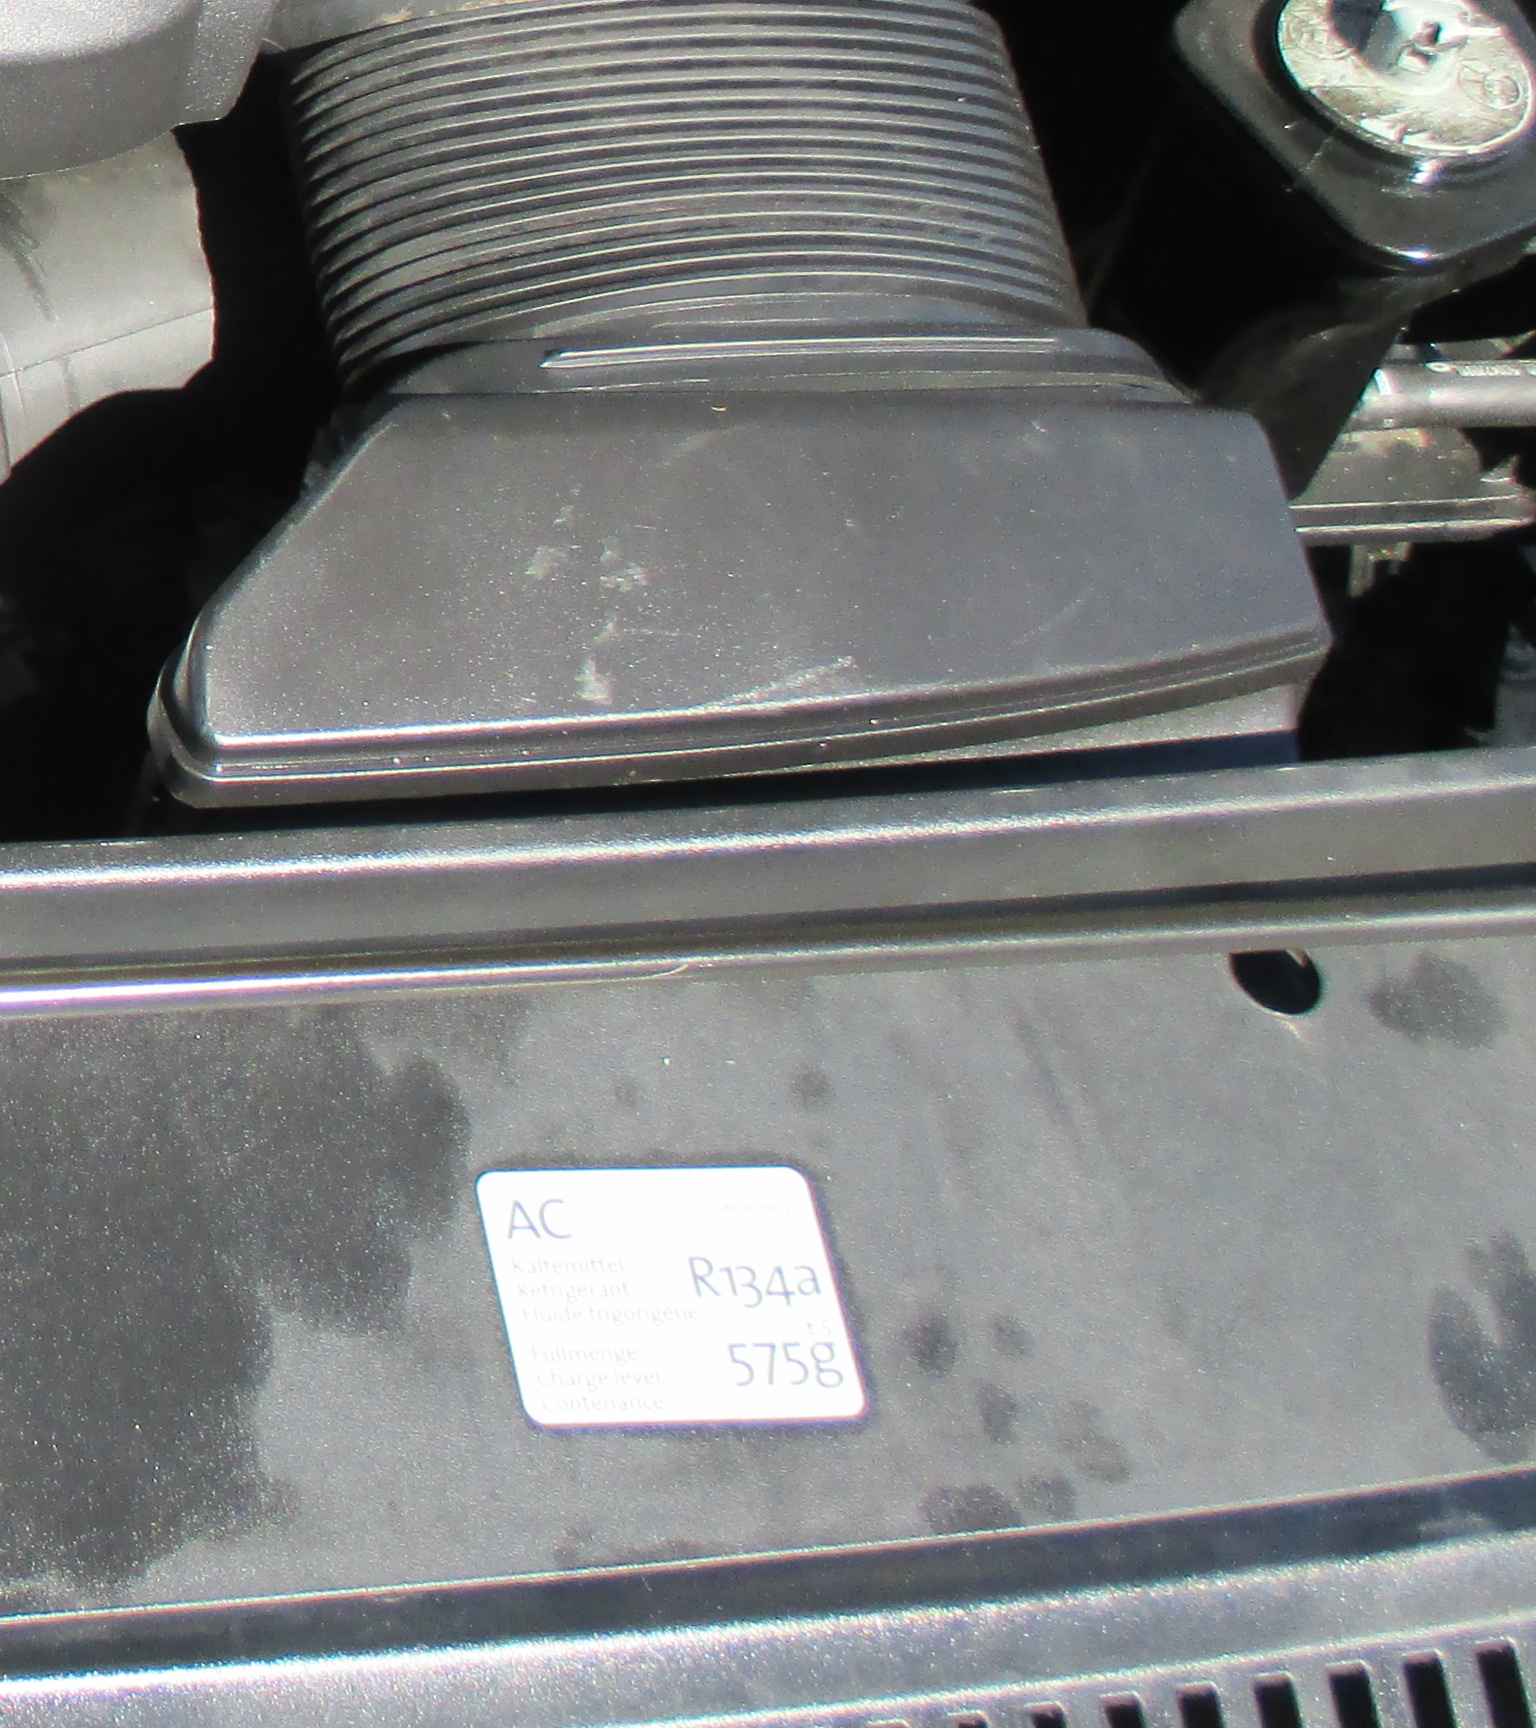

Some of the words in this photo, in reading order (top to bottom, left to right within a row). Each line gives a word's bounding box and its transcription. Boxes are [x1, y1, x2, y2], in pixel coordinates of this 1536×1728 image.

[506, 1198, 574, 1240] AC
[687, 1254, 826, 1309] R134a
[726, 1341, 846, 1390] 575g
